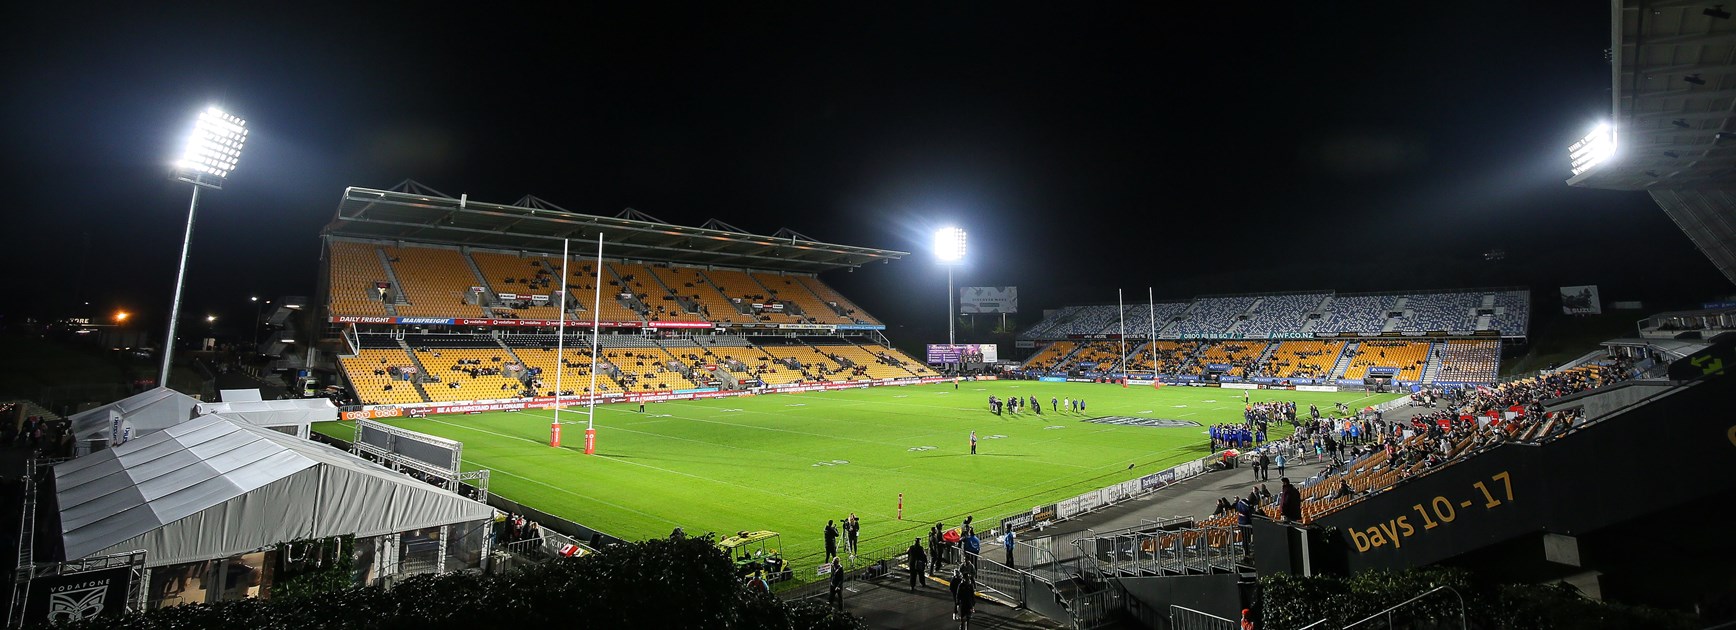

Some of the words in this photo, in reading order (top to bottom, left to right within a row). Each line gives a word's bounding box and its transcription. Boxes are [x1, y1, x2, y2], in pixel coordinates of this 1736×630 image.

[451, 404, 489, 412] GRANDSTAND
[489, 402, 526, 411] MILLIONAIRE
[347, 410, 371, 420] TNT
[374, 408, 398, 418] TNT
[1348, 515, 1415, 553] bays
[1413, 495, 1456, 530] 10
[1473, 470, 1514, 509] 17
[51, 578, 111, 592] VODAFONE
